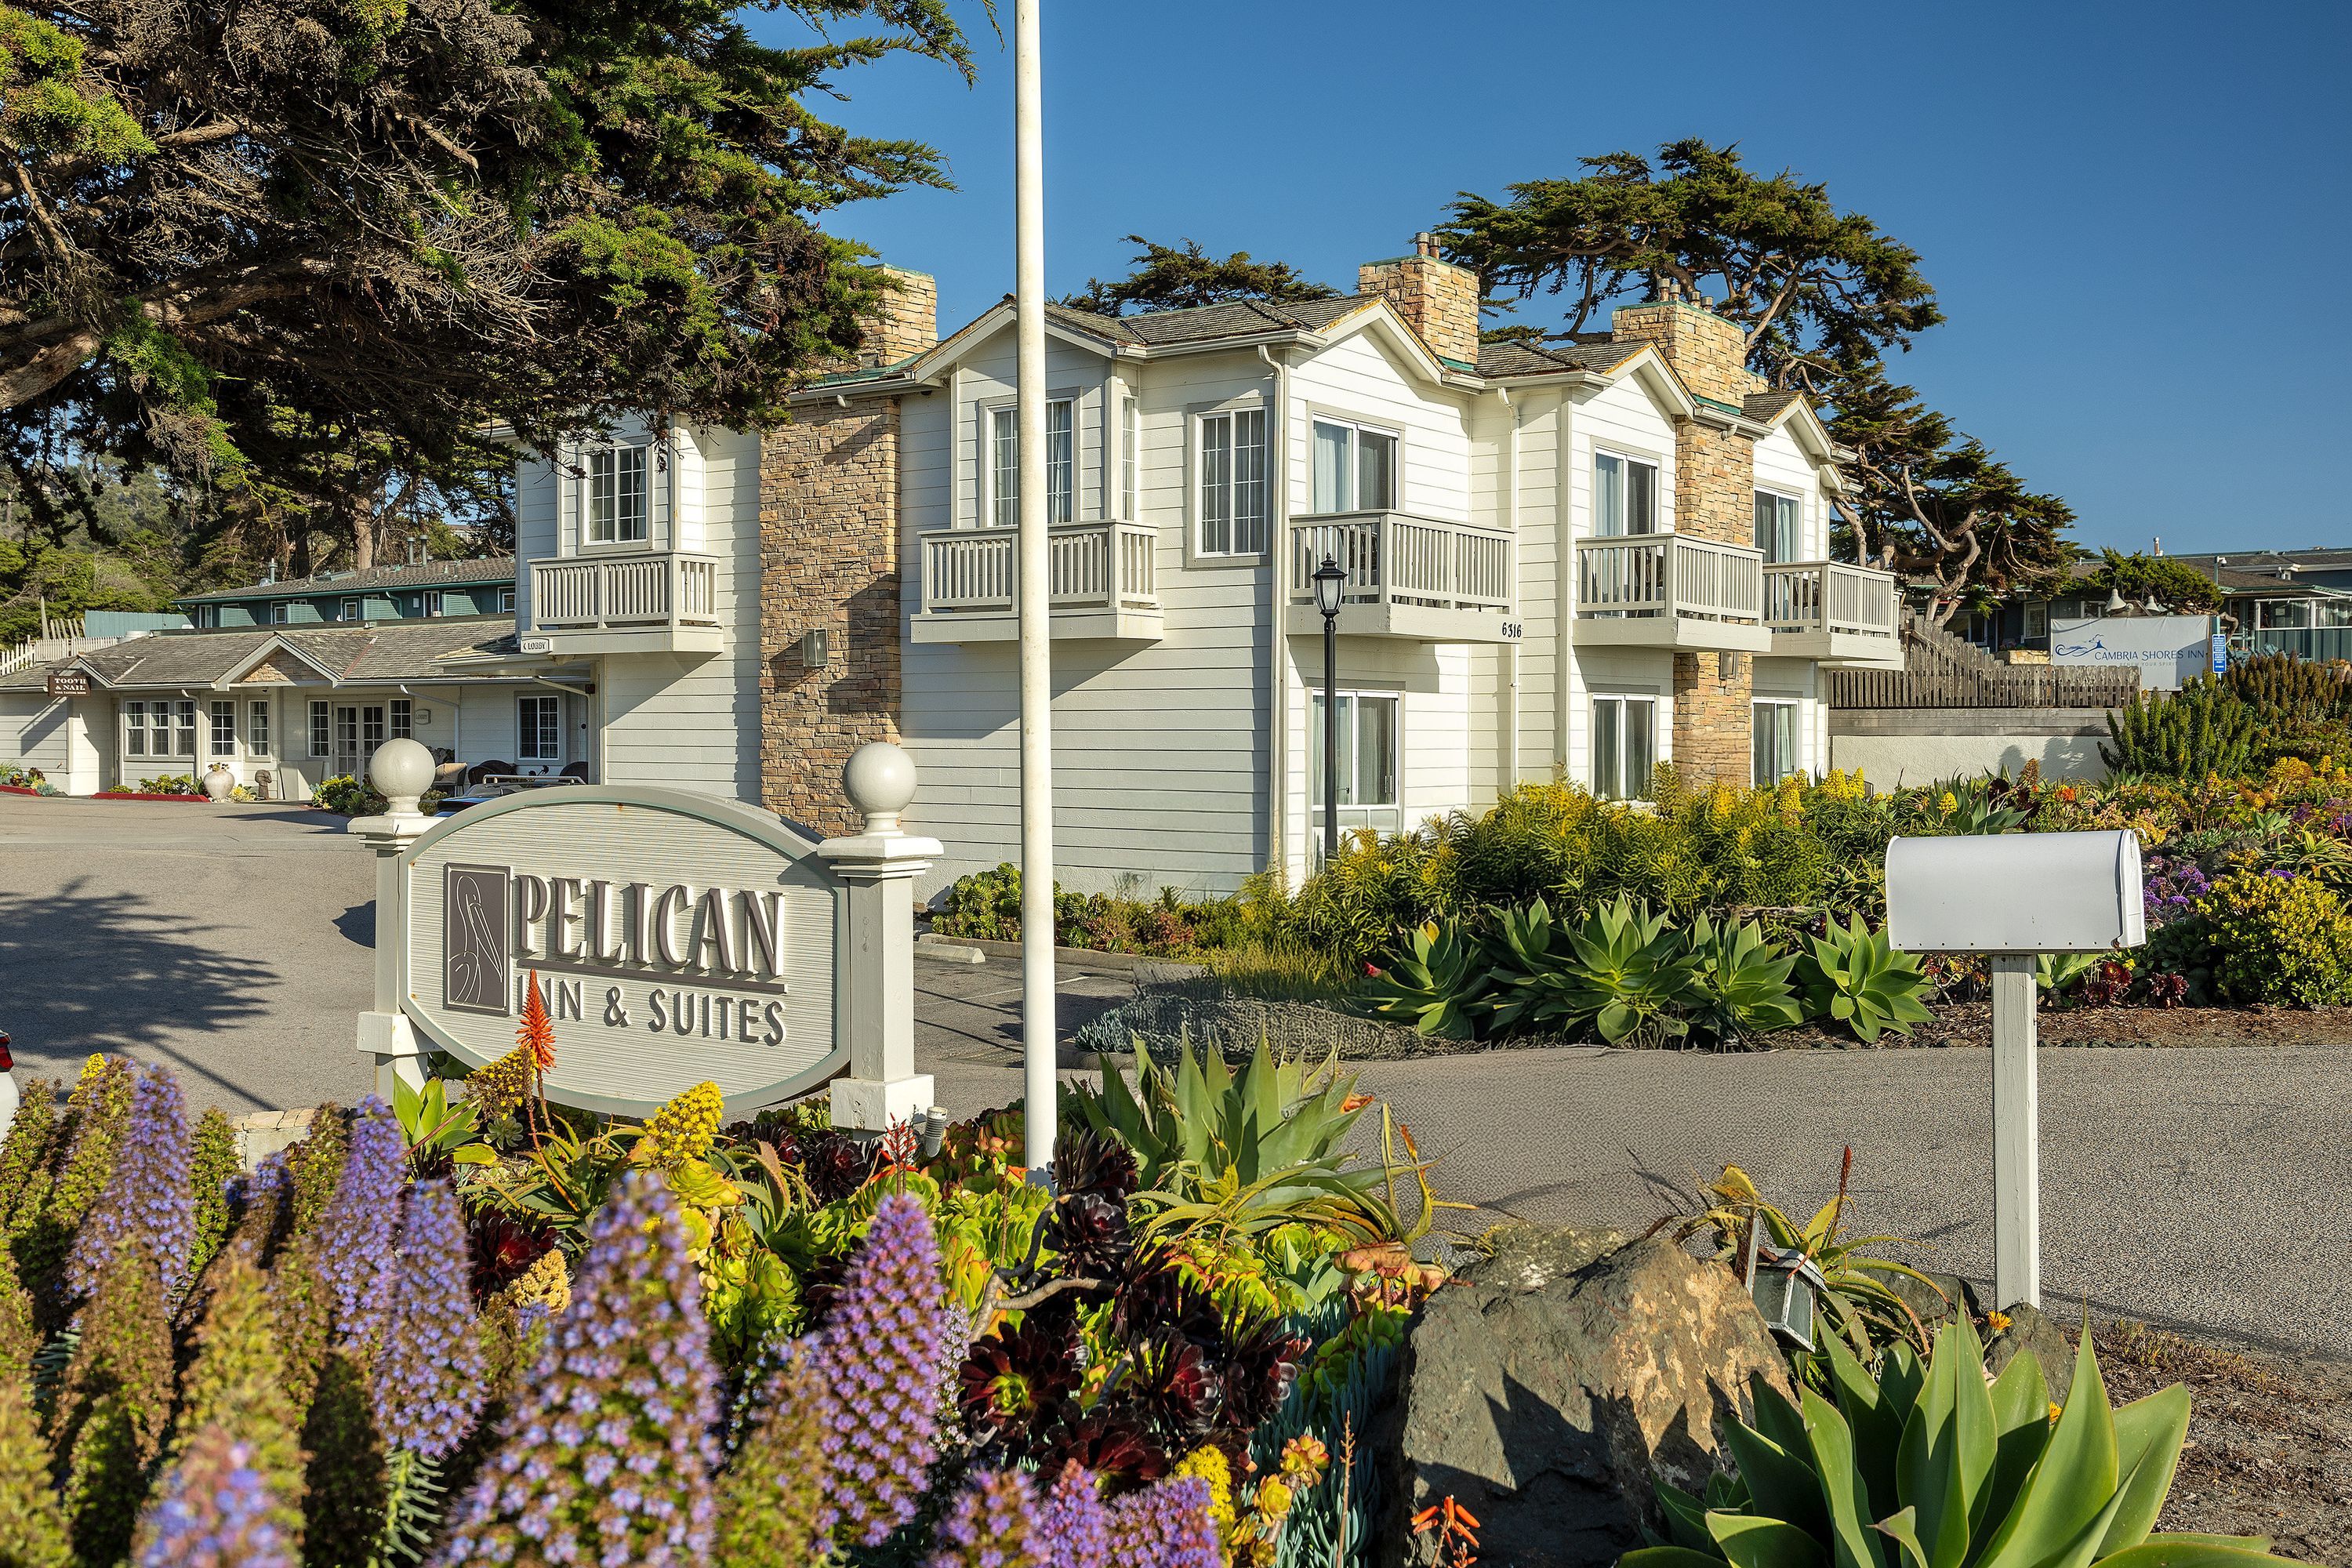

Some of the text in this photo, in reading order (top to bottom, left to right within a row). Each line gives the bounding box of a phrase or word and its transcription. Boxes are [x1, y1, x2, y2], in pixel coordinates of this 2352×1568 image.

[1502, 622, 1522, 638] 6316
[528, 641, 546, 650] LOBBY
[2094, 650, 2205, 661] CAMBRIA SHORES INN
[516, 874, 786, 977] PELICAN
[603, 985, 632, 1028] &
[648, 988, 786, 1047] SUITES
